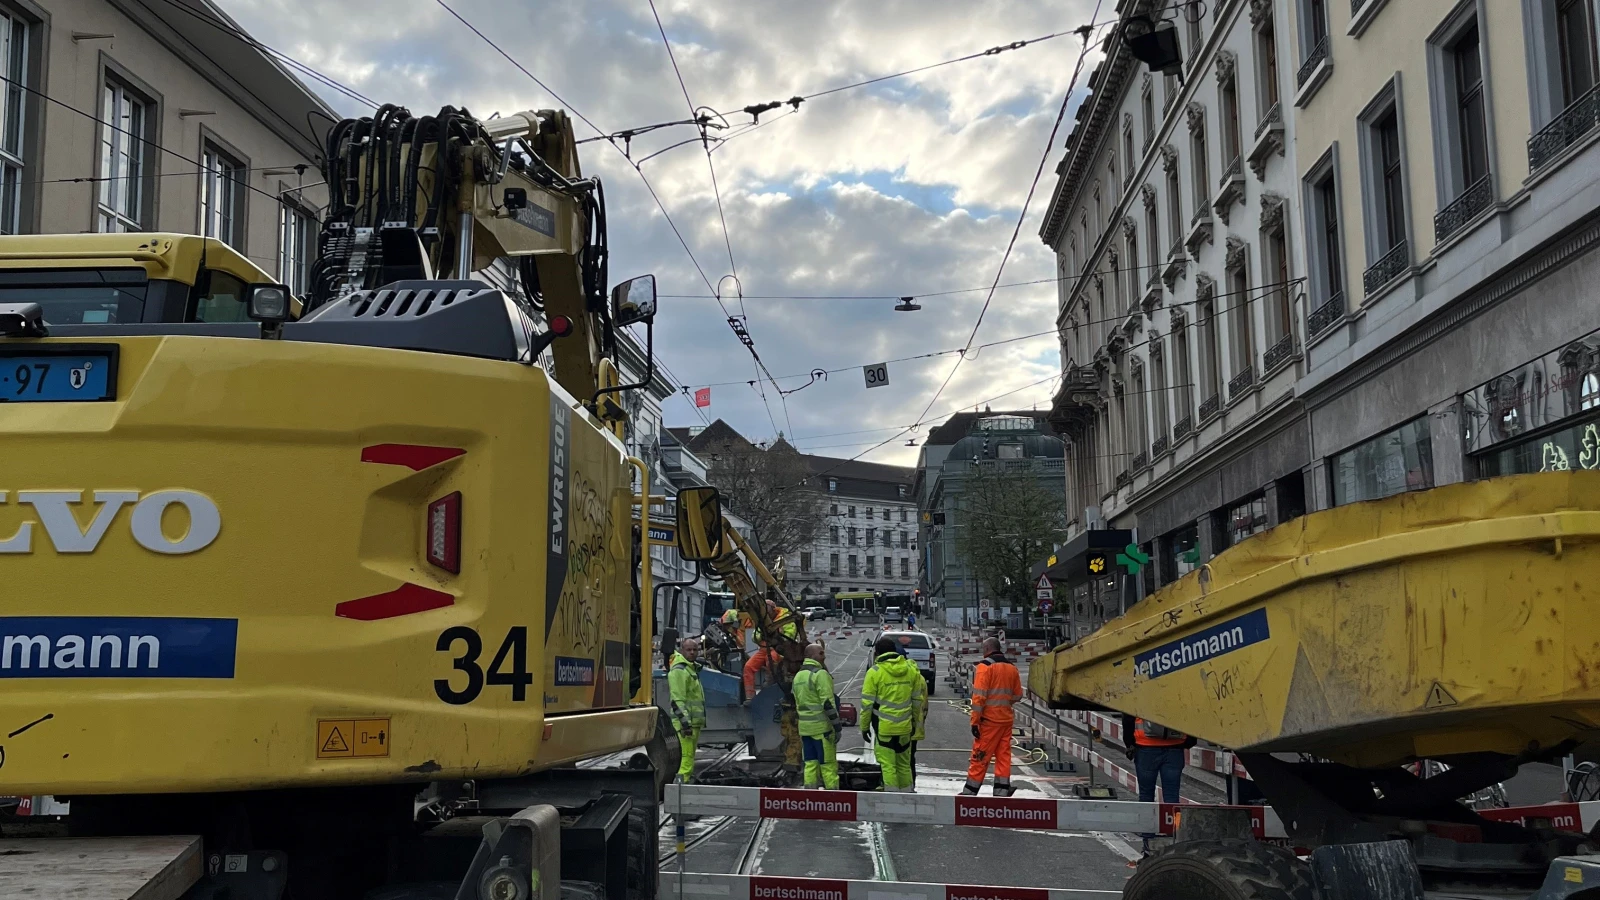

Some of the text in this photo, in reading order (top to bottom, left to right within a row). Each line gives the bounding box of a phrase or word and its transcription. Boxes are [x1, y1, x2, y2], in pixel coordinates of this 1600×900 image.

[867, 367, 886, 383] 30
[552, 403, 565, 554] EWR150E
[434, 626, 533, 705] 34
[558, 659, 592, 682] bertschmann
[605, 665, 624, 681] VOLVO
[764, 796, 851, 813] bertschmann
[959, 804, 1051, 821] bertschmann
[754, 885, 843, 900] bertschmann
